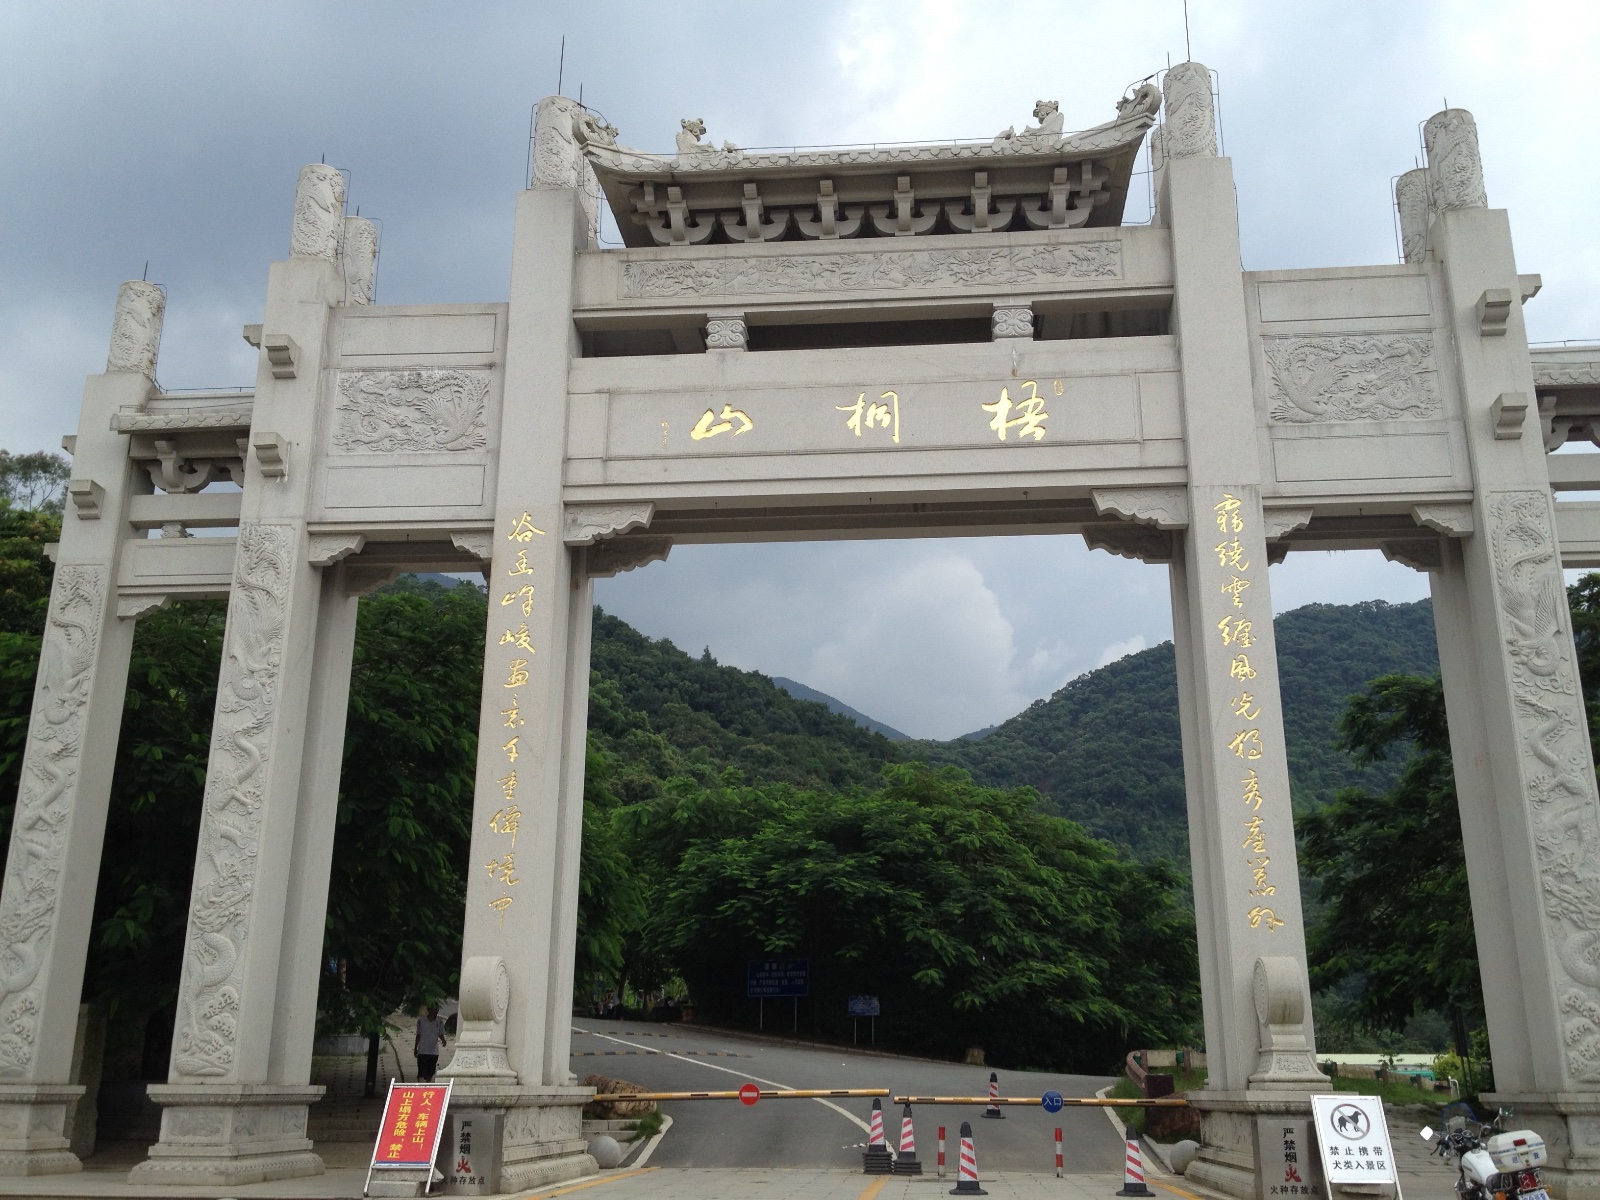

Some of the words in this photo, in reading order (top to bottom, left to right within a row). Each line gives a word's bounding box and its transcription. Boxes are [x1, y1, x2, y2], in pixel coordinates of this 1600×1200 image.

[1044, 1097, 1062, 1106] 入口
[456, 1121, 472, 1174] 严禁烟火
[1329, 1146, 1383, 1157] 禁止携带
[1283, 1127, 1302, 1183] 严禁烟火
[1332, 1160, 1387, 1171] 犬类入景区
